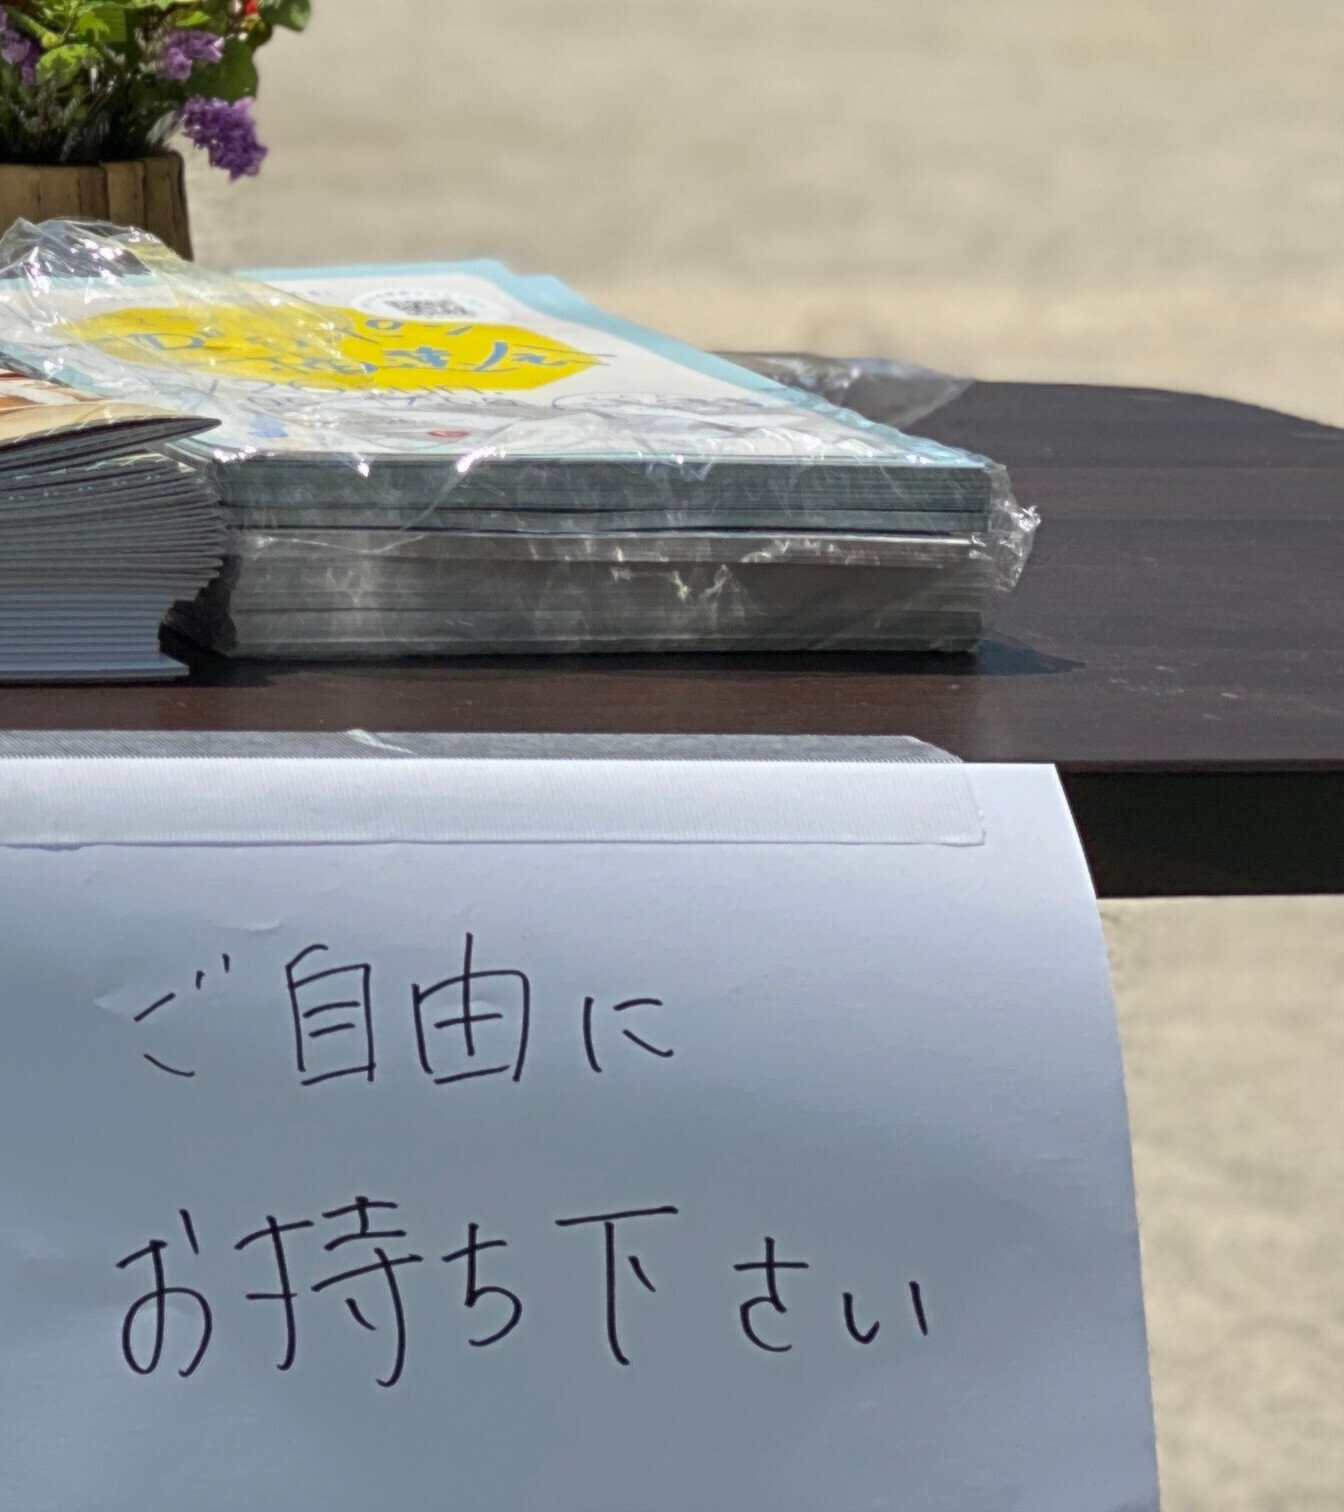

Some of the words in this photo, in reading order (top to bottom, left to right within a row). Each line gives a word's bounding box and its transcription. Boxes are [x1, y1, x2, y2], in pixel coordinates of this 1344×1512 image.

[132, 931, 676, 1088] ご自由に
[114, 1194, 929, 1389] お持ち下さい
